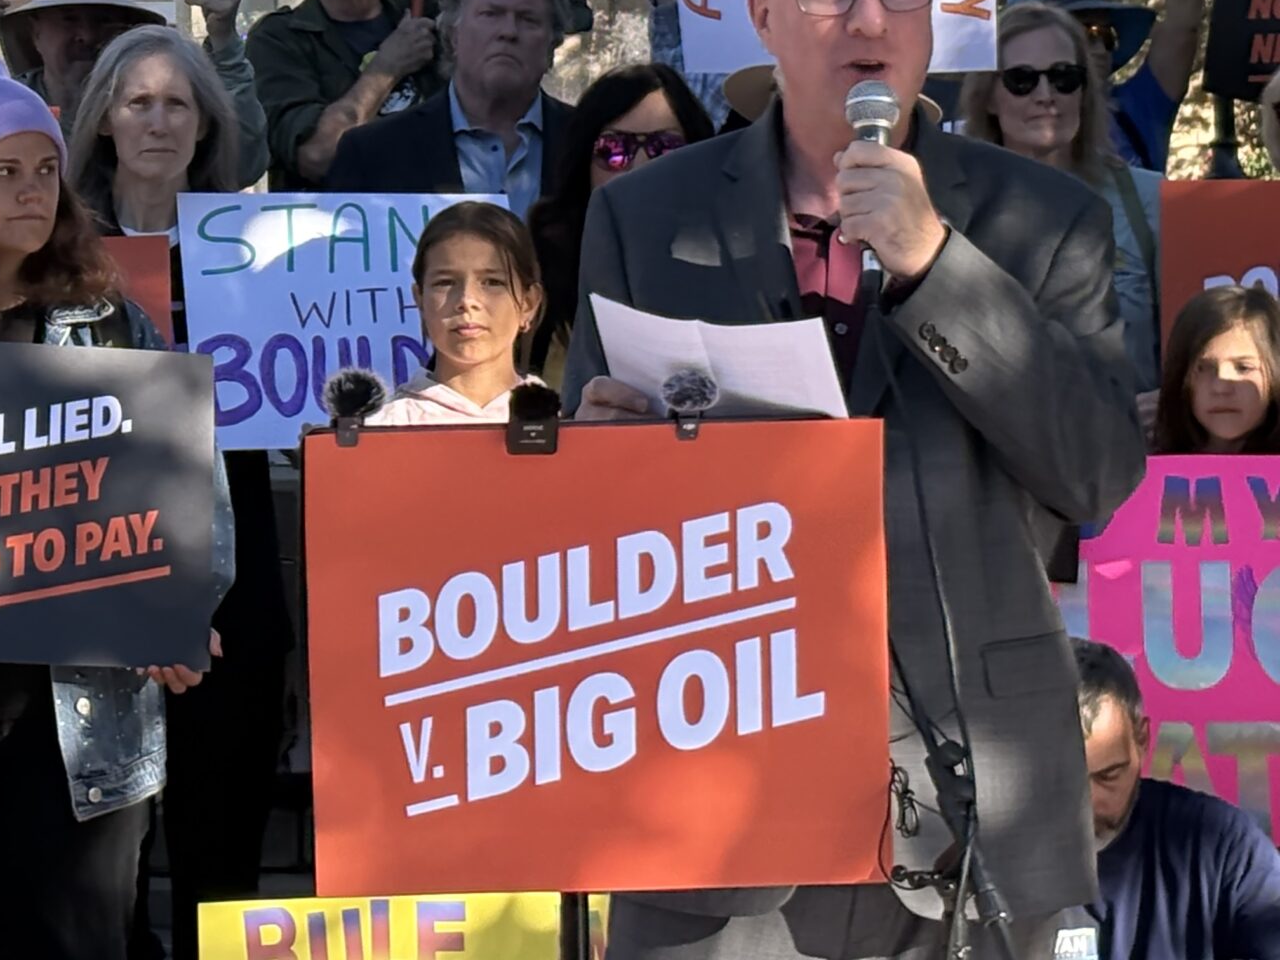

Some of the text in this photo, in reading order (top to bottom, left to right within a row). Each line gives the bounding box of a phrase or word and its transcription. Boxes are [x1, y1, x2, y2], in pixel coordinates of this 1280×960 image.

[23, 395, 132, 451] LIED.
[6, 528, 66, 578] TO
[75, 510, 163, 567] PAY.
[378, 502, 795, 678] BOULDER
[400, 629, 825, 803] V. BIG OIL
